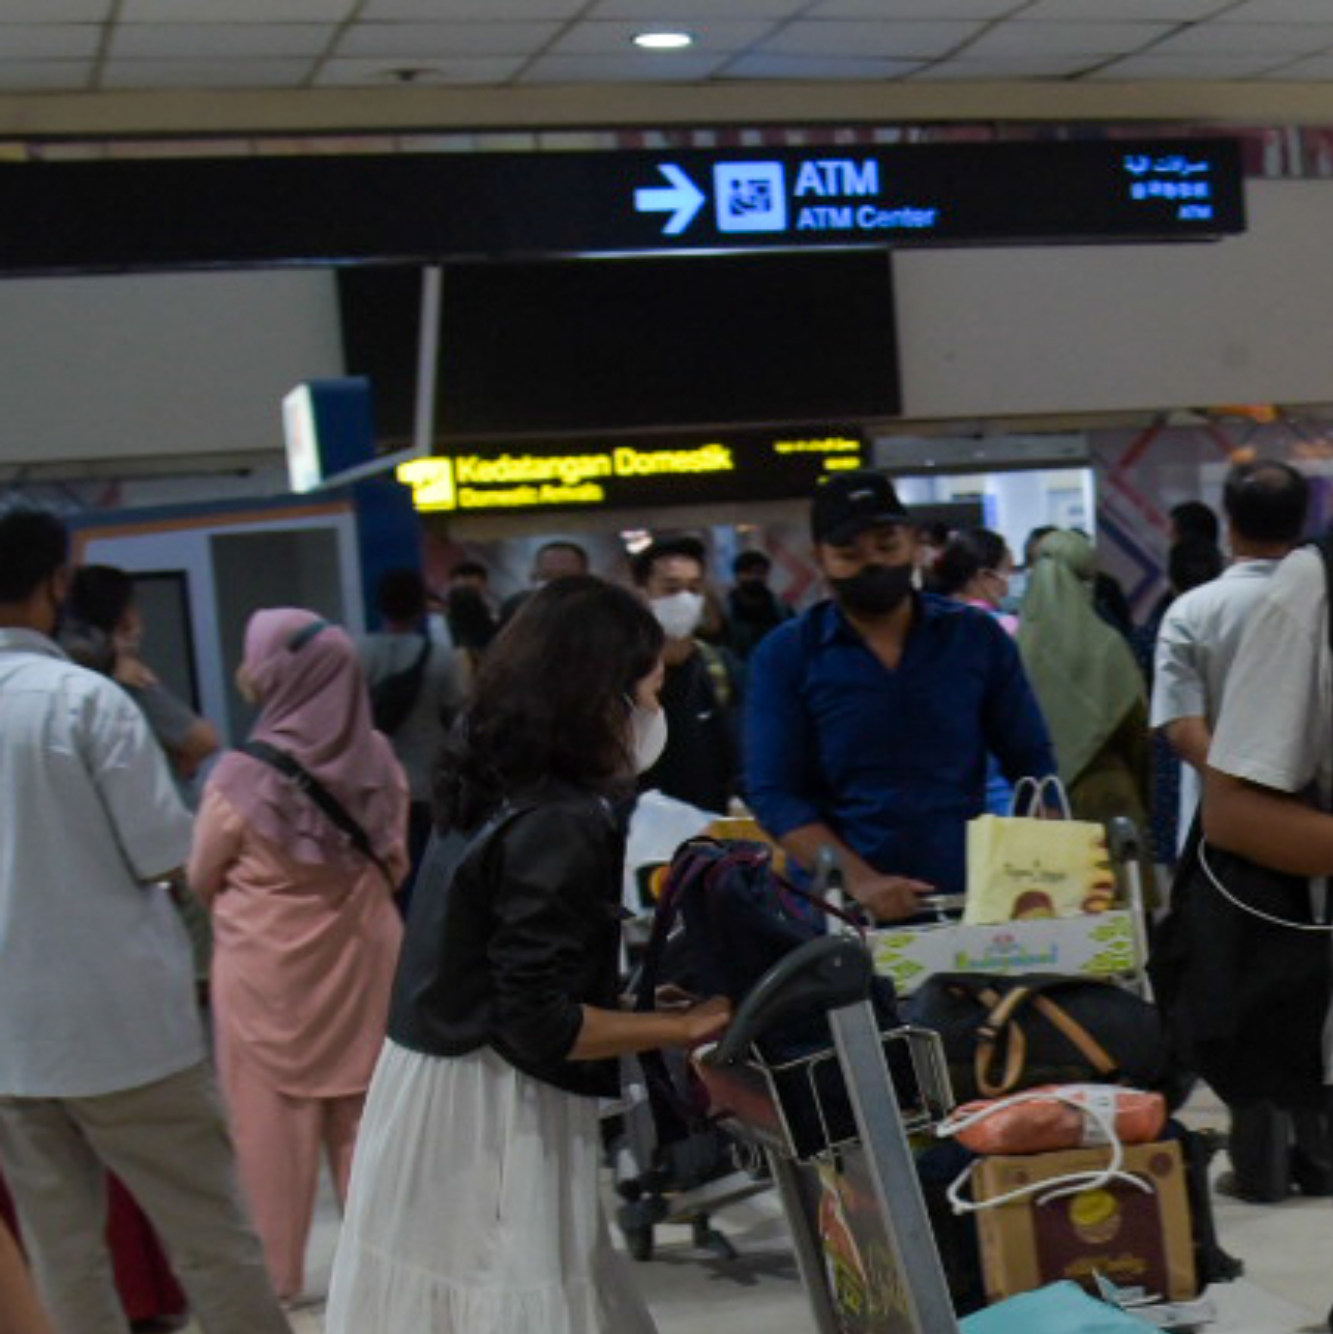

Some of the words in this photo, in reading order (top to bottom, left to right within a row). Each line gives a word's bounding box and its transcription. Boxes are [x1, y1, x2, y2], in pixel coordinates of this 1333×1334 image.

[794, 159, 878, 197] ATM
[797, 206, 853, 230] ATM
[857, 205, 938, 229] Center
[456, 453, 611, 485] Kedatangan
[613, 443, 734, 476] Domestik
